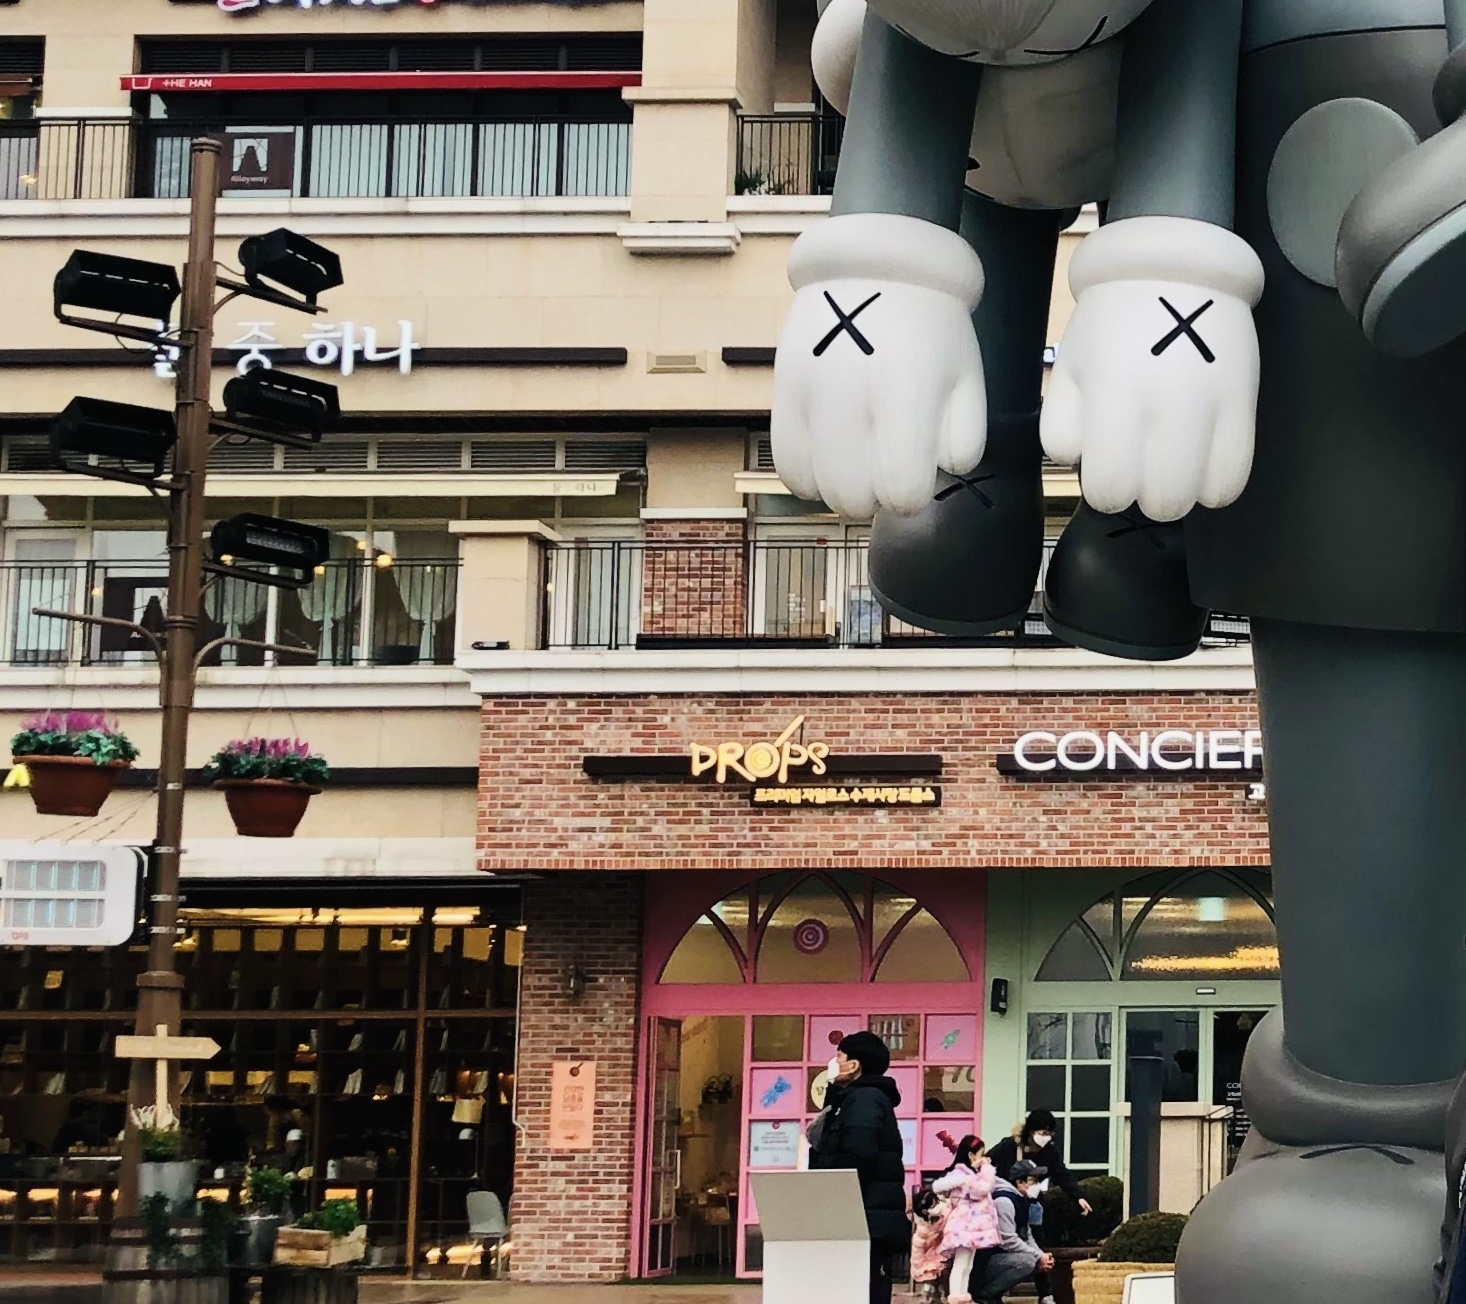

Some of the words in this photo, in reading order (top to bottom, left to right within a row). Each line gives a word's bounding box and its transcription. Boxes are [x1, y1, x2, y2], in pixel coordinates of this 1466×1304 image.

[226, 321, 284, 376] 중
[302, 319, 421, 376] 하나
[689, 715, 830, 784] DROPS
